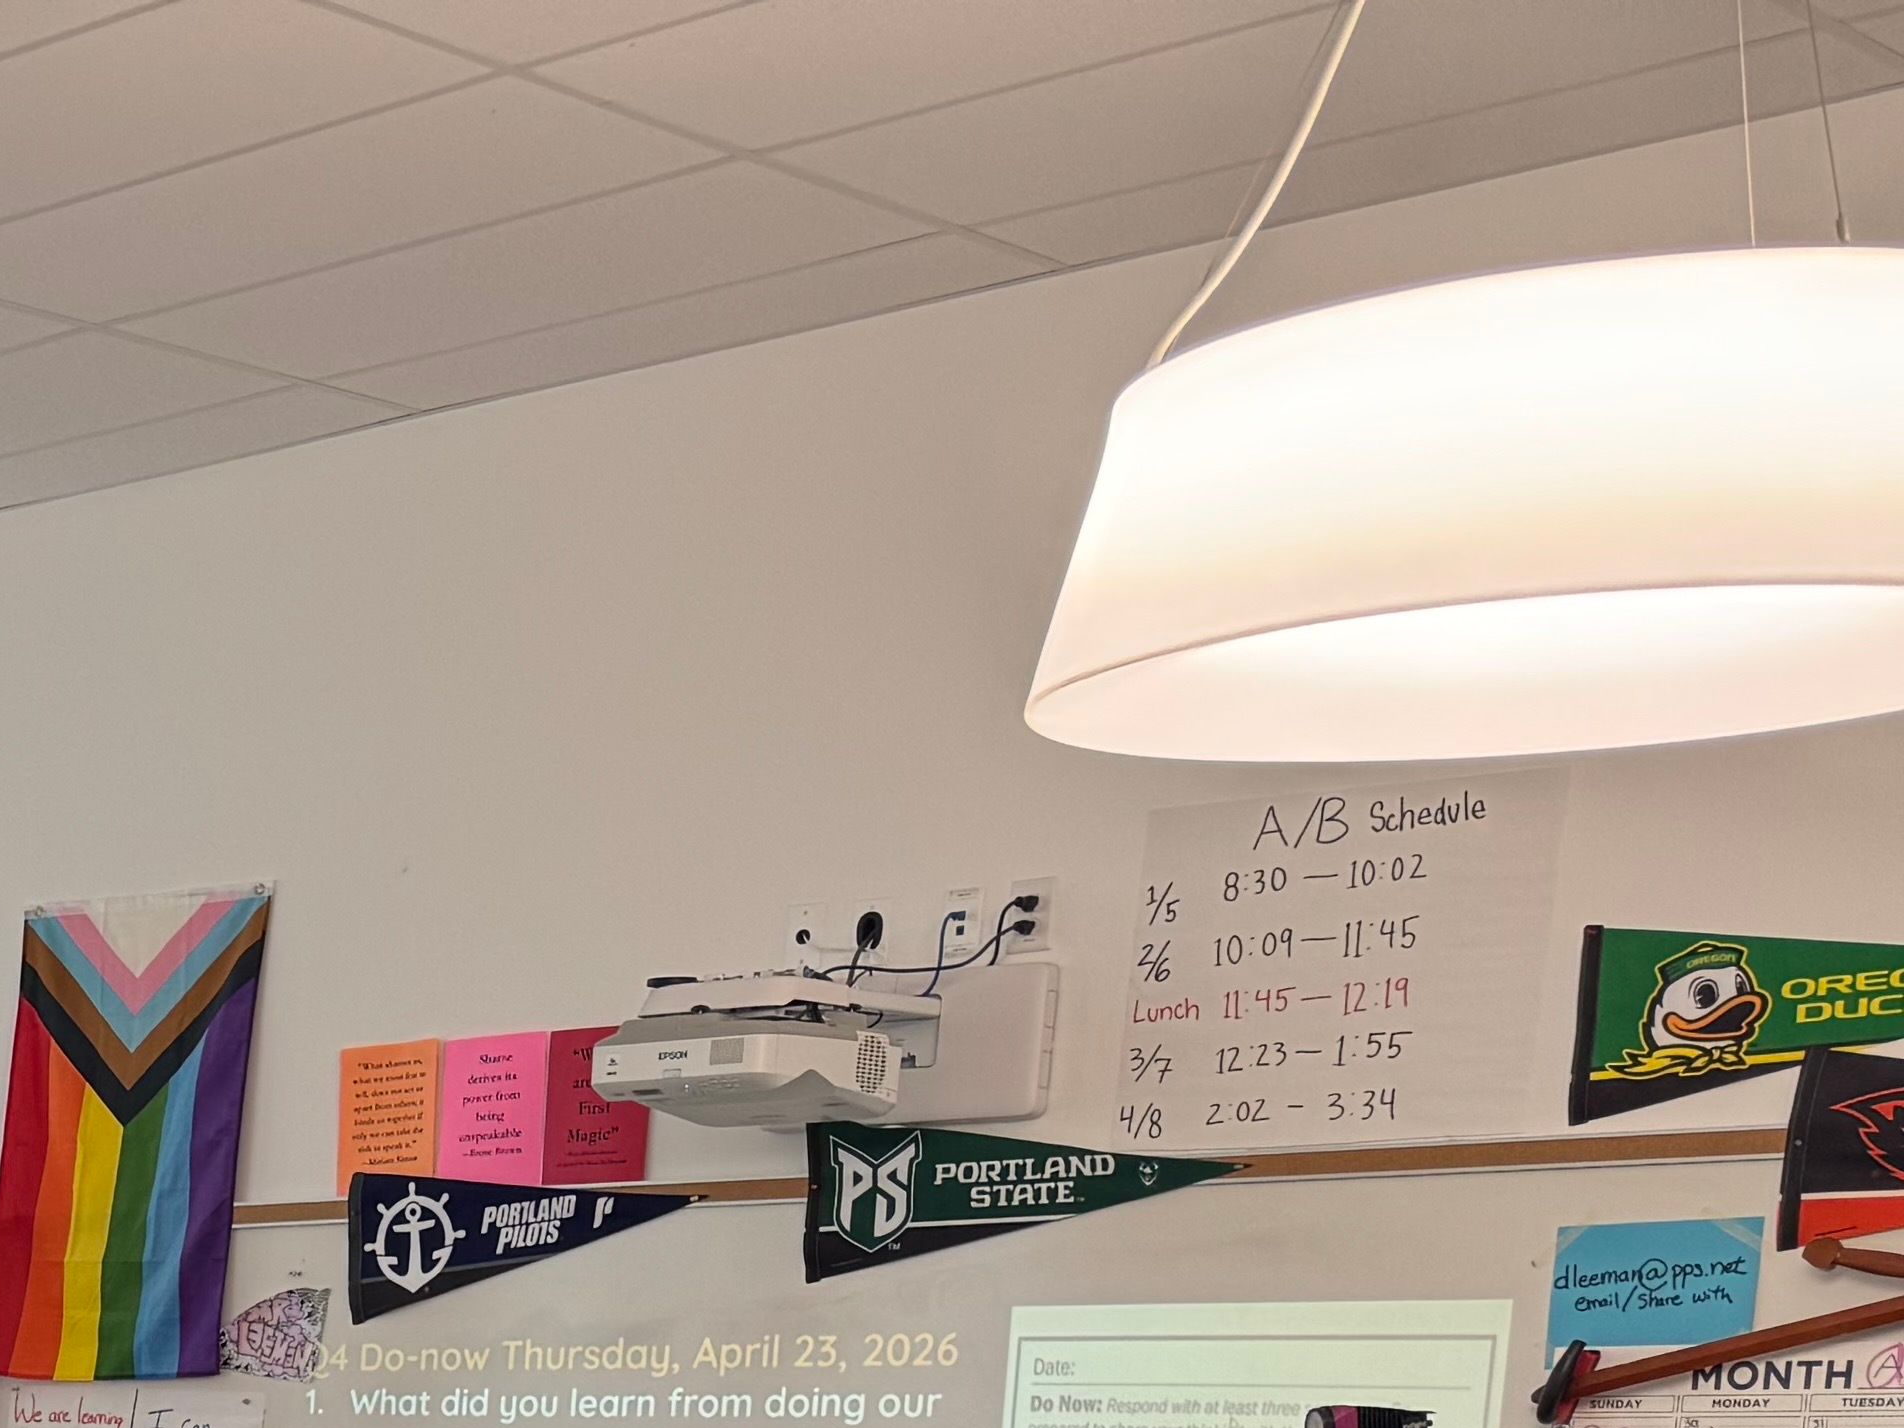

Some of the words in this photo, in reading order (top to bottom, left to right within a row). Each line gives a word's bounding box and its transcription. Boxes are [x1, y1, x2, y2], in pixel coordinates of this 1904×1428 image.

[1369, 790, 1486, 833] Schedule
[1223, 866, 1287, 902] 8:30
[1347, 853, 1427, 890] 10:02
[1214, 927, 1293, 967] 10:09
[1343, 914, 1420, 958] 11:45
[1133, 997, 1200, 1024] Lunch
[1223, 986, 1297, 1020] 11:45
[1343, 977, 1409, 1016] 12:19
[658, 1050, 688, 1060] EPSON
[1129, 1043, 1173, 1084] 3/7
[1215, 1041, 1287, 1075] 12:23
[1332, 1030, 1414, 1067] 1:55
[1119, 1102, 1162, 1140] 4/8
[1205, 1098, 1270, 1126] 2:02
[1327, 1087, 1396, 1121] 3:34
[934, 1155, 1115, 1185] PORTLAND
[970, 1182, 1075, 1208] STATE
[481, 1195, 576, 1234] PORTLAND
[496, 1220, 561, 1254] PILOTS
[1554, 1257, 1747, 1290] dleeman@pps.net
[1693, 1288, 1733, 1304] with
[360, 1343, 491, 1372] Do-now
[502, 1337, 680, 1378] Thursday,
[692, 1334, 780, 1377] April
[793, 1334, 847, 1373] 23,
[863, 1331, 959, 1367] 2026
[1034, 1358, 1075, 1377] Date:
[1692, 1360, 1853, 1391] MONTH
[49, 1412, 71, 1423] are
[305, 1388, 324, 1415] 1.
[350, 1387, 431, 1417] What
[440, 1387, 489, 1417] did
[499, 1395, 559, 1425] you
[570, 1387, 655, 1418] learn
[667, 1386, 752, 1419] from
[764, 1386, 866, 1426] doing
[878, 1393, 943, 1418] our
[1030, 1396, 1054, 1412] Do
[1059, 1397, 1102, 1413] Now:
[1590, 1399, 1642, 1409] SUNDAY
[1712, 1399, 1771, 1408] MONDAY
